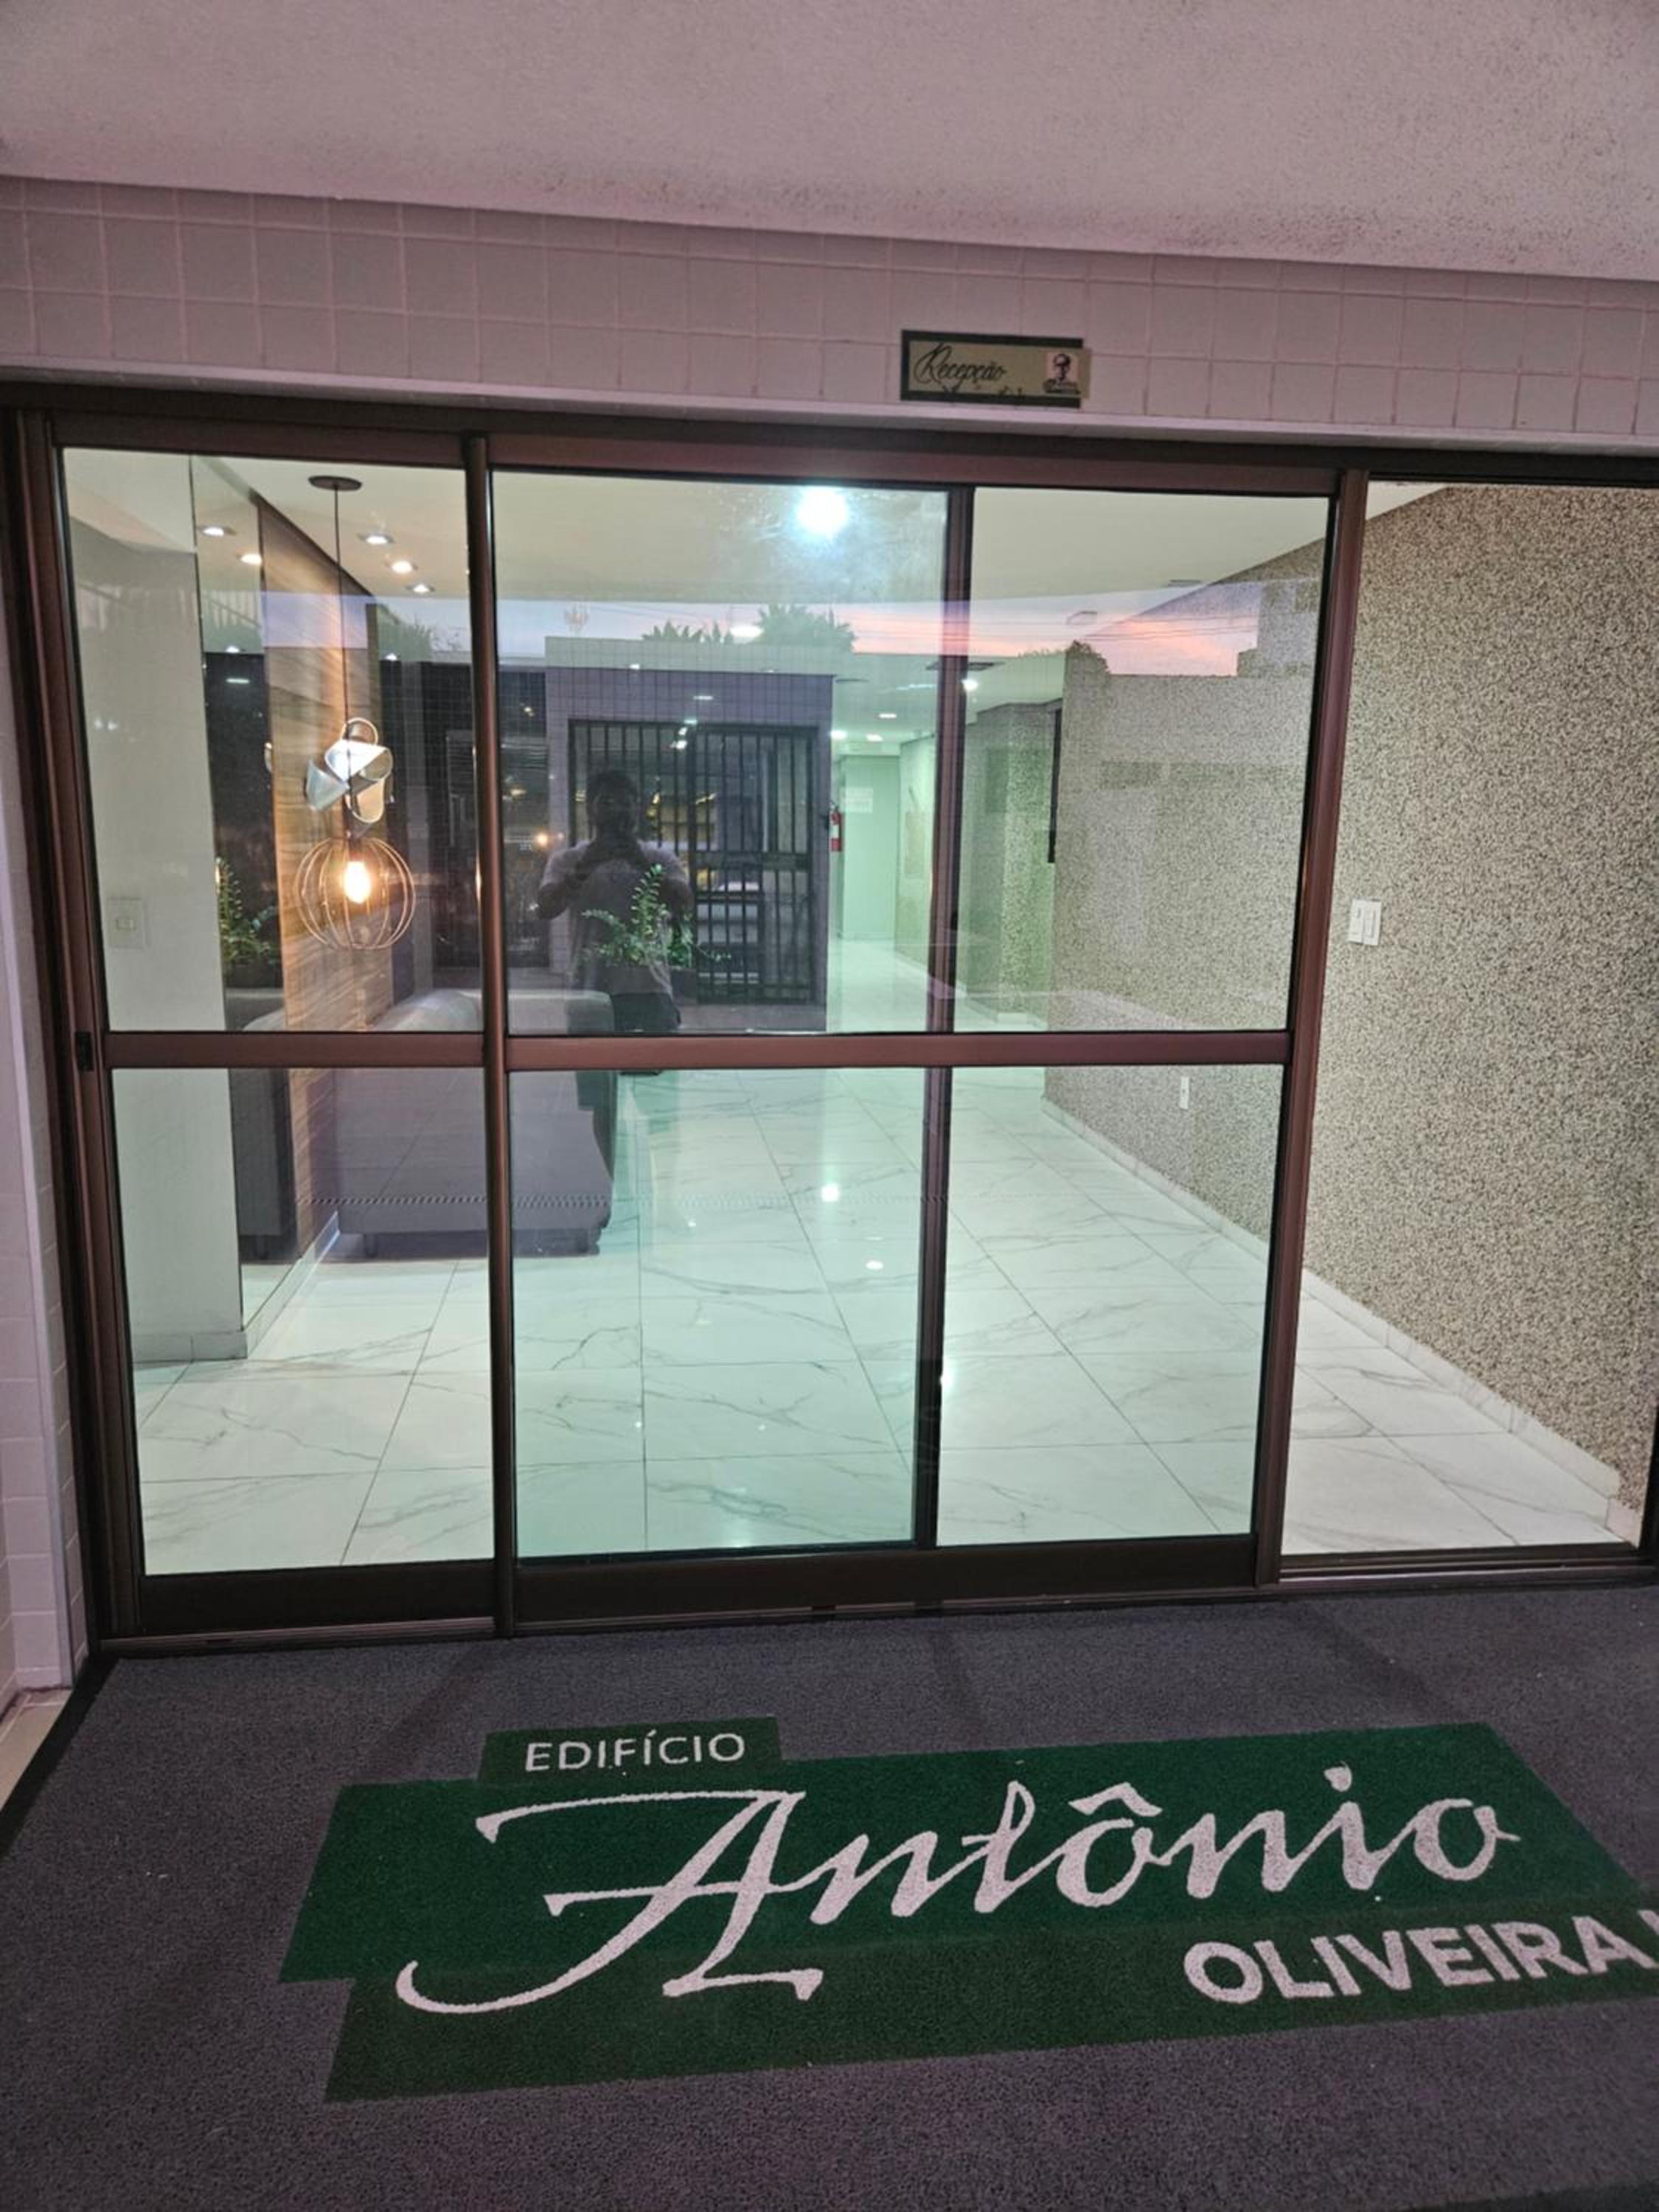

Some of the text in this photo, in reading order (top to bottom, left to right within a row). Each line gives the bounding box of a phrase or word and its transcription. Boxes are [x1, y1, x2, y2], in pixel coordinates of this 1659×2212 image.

[525, 1729, 745, 1772] EDIFÍCIO
[396, 1762, 1521, 2014] Antônio
[1183, 1915, 1659, 2004] OLIVEIRA
